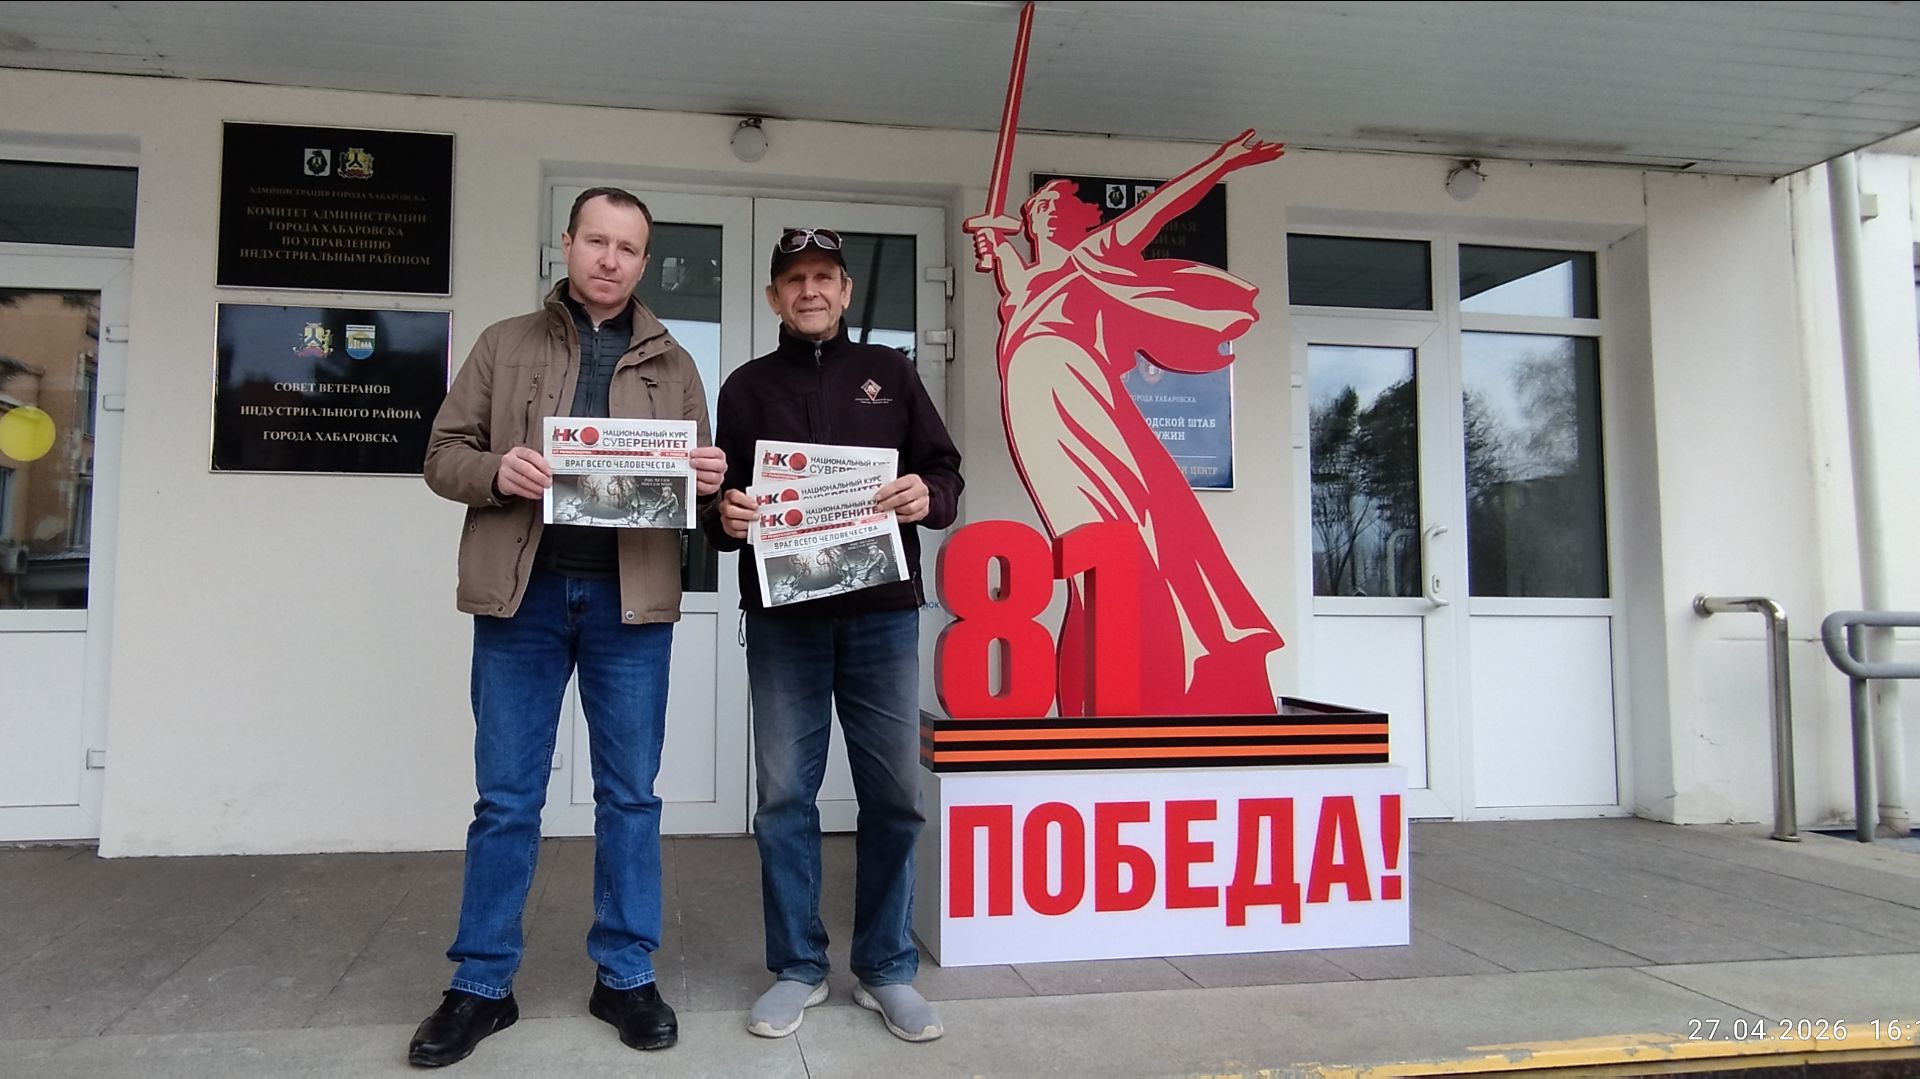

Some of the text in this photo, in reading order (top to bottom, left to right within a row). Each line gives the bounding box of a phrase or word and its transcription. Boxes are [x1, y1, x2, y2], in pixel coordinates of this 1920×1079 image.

[249, 186, 427, 203] АДМИНИСТРАЦИЯ ГОРОДА ХАБАРОВСКА
[246, 206, 427, 224] КОМИТЕТ АДМИНИСТРАЦИИ
[268, 221, 404, 237] ГОРОДА ХАБАРОВСКА
[282, 236, 392, 250] ПО УПРАВЛЕНИЮ
[239, 248, 431, 266] ИНДУСТРИАЛЬНЫМ РАЙОНОМ
[274, 382, 391, 394] СОВЕТ ВЕТЕРАНОВ
[1155, 395, 1197, 403] ХАБАРОВСКА
[240, 405, 422, 420] ИНДУСТРИАЛЬНОГО РАЙОНА
[1188, 418, 1216, 428] ШТАБ
[263, 430, 399, 443] ГОРОДА ХАБАРОВСКА
[602, 429, 667, 438] НАЦИОНАЛЬНЫЙ
[1153, 431, 1185, 441] УЖИН
[602, 437, 688, 449] СУВЕРЕНИТЕТ
[565, 459, 676, 469] ВРАГ ВСЕГО ЧЕЛОВЕЧЕСТВА
[810, 456, 872, 467] НАЦИОНАЛЬНЫЙ
[1190, 466, 1218, 476] ЦЕНТР
[801, 478, 862, 496] НАЦИОНАЛЬНЫЙ
[863, 475, 882, 486] КУРС
[805, 500, 861, 515] НАЦИОНАЛЬНЫЙ
[805, 505, 886, 526] СУВЕРЕНИТЕ
[774, 525, 878, 549] ВРАГ ВСЕГО ЧЕЛОВЕЧЕСТВА
[936, 519, 1143, 718] 81
[949, 794, 1402, 927] ПОБЕДА!
